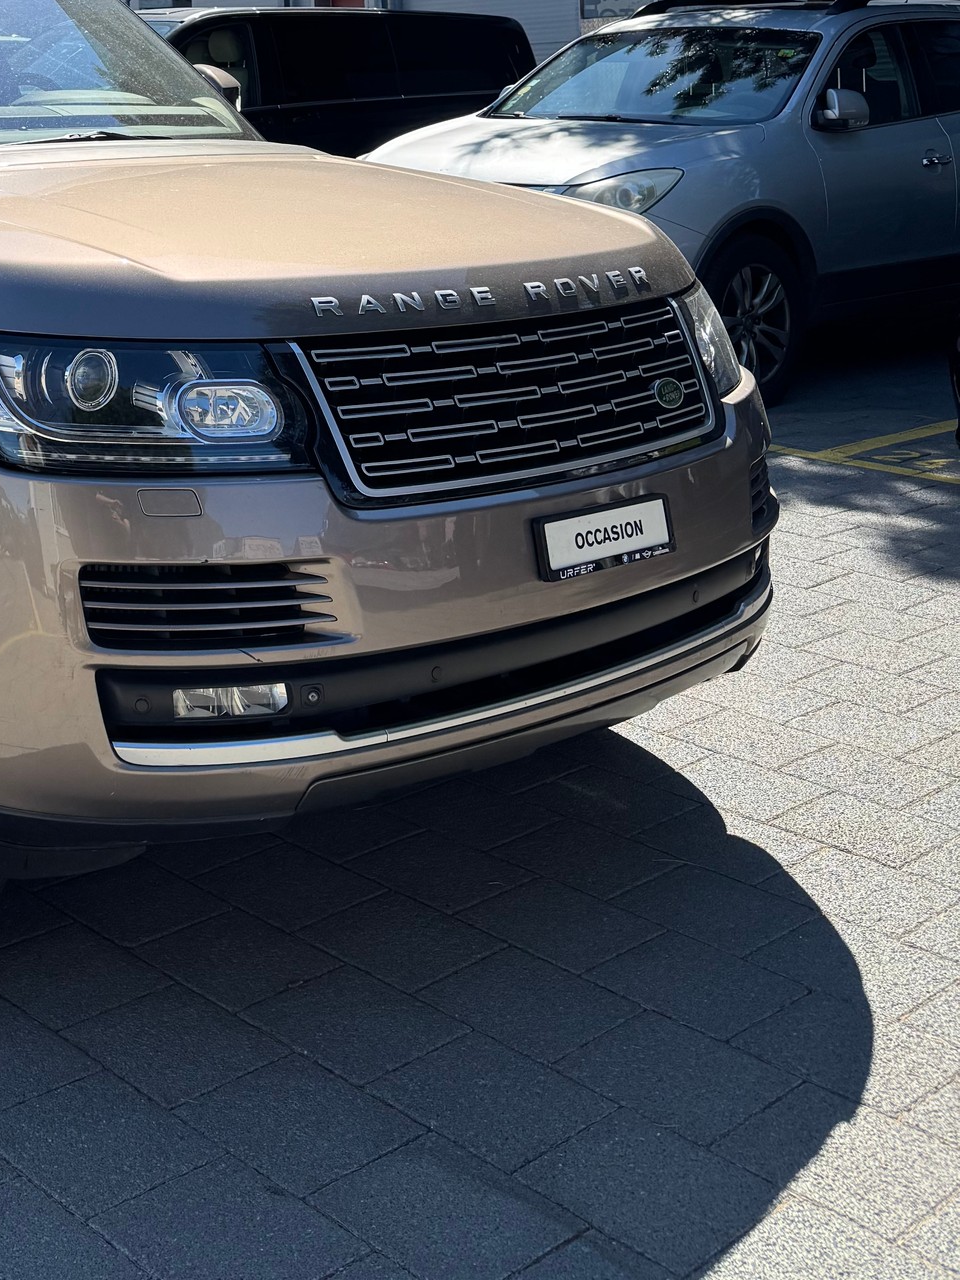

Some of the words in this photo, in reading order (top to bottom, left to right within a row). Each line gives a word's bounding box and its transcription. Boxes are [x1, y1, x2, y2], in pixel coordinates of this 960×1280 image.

[310, 287, 496, 318] RANGE
[524, 266, 649, 302] ROVER
[575, 519, 644, 549] OCCASION
